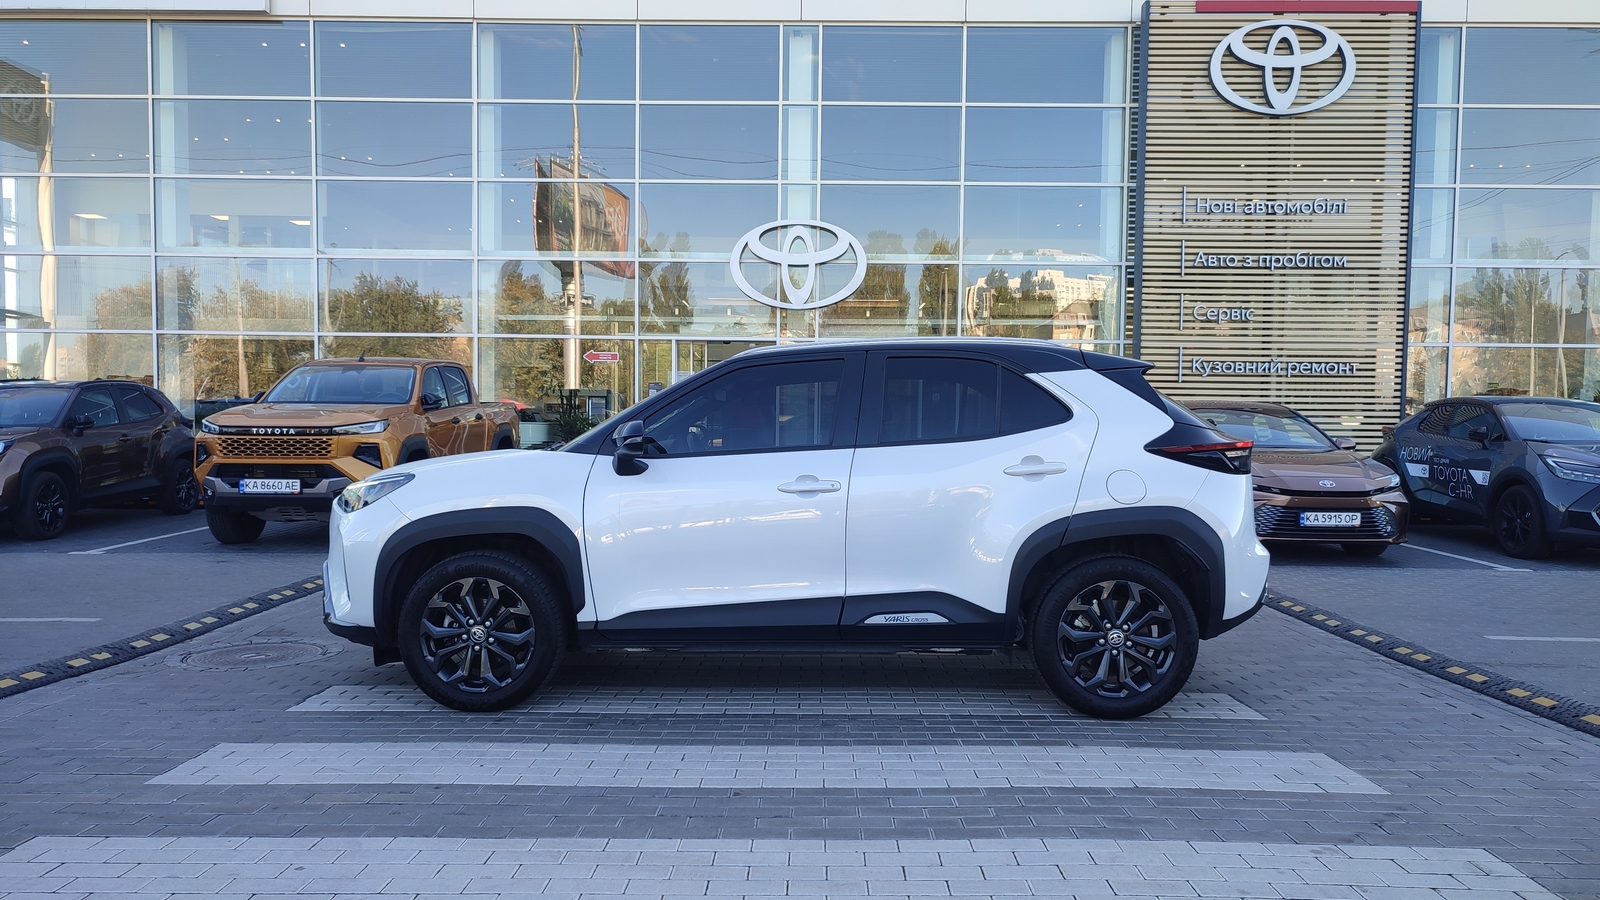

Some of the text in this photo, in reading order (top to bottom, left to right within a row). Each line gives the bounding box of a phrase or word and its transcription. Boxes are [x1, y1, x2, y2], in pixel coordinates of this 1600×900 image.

[1196, 197, 1348, 214] Нові автомобілі
[1193, 251, 1348, 271] Авто з пробігом
[1193, 304, 1256, 324] Сервіс
[1191, 357, 1359, 377] Кузовний ремонт
[1399, 446, 1432, 461] НОВИЙ
[1433, 465, 1468, 483] TOYOTA
[245, 481, 298, 490] KA 8660 AE
[1448, 482, 1474, 499] C-HR
[1305, 514, 1358, 523] KA 5915 OP
[883, 615, 910, 623] YARIS
